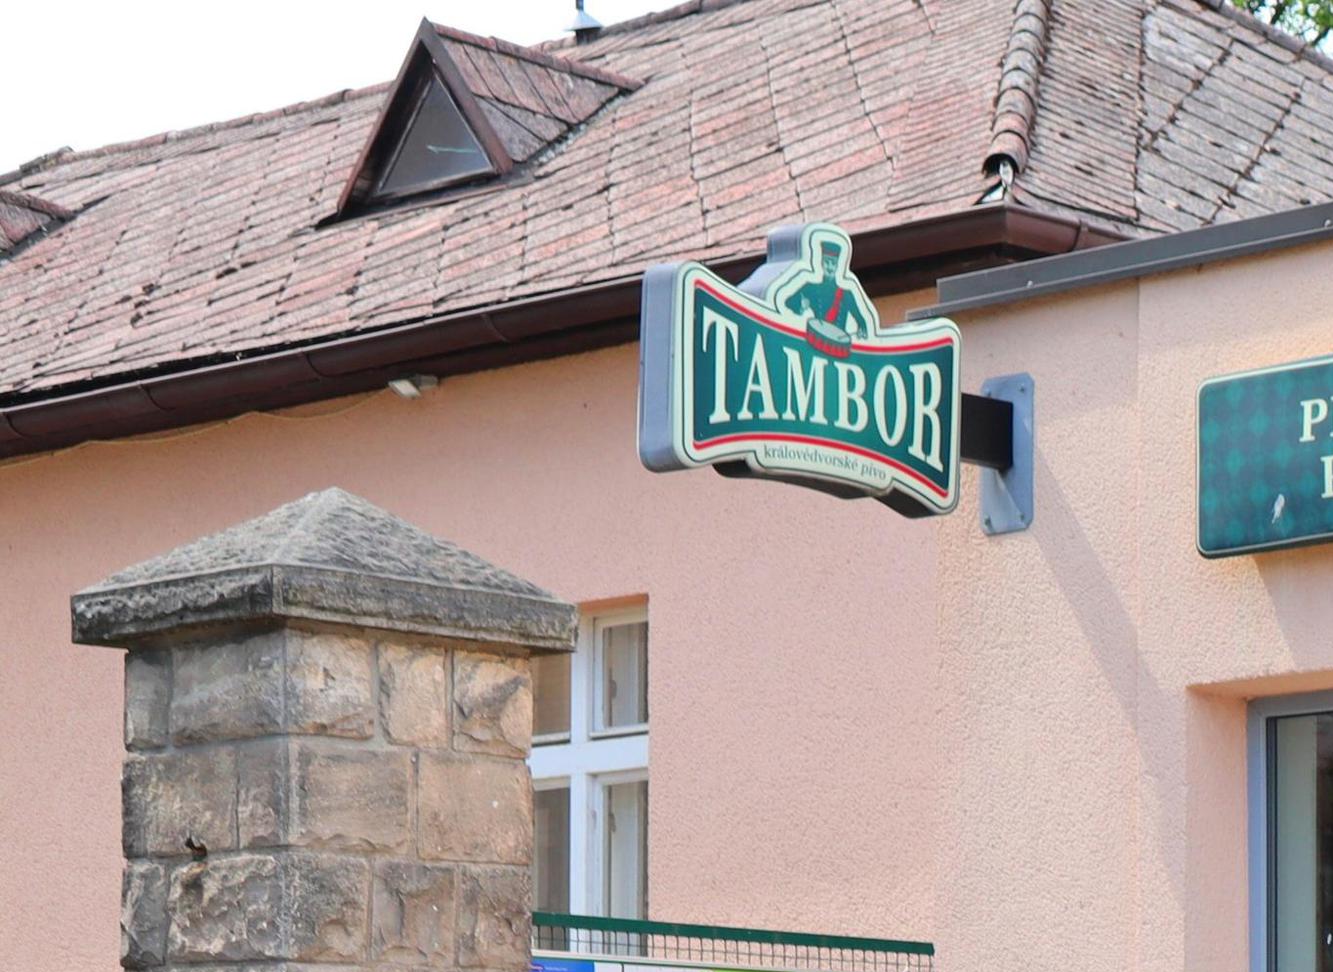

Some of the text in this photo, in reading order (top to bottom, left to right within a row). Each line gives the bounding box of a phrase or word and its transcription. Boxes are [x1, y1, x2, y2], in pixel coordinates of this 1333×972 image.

[702, 304, 945, 474] TAMBOR
[764, 444, 887, 480] královédvorské pivo
